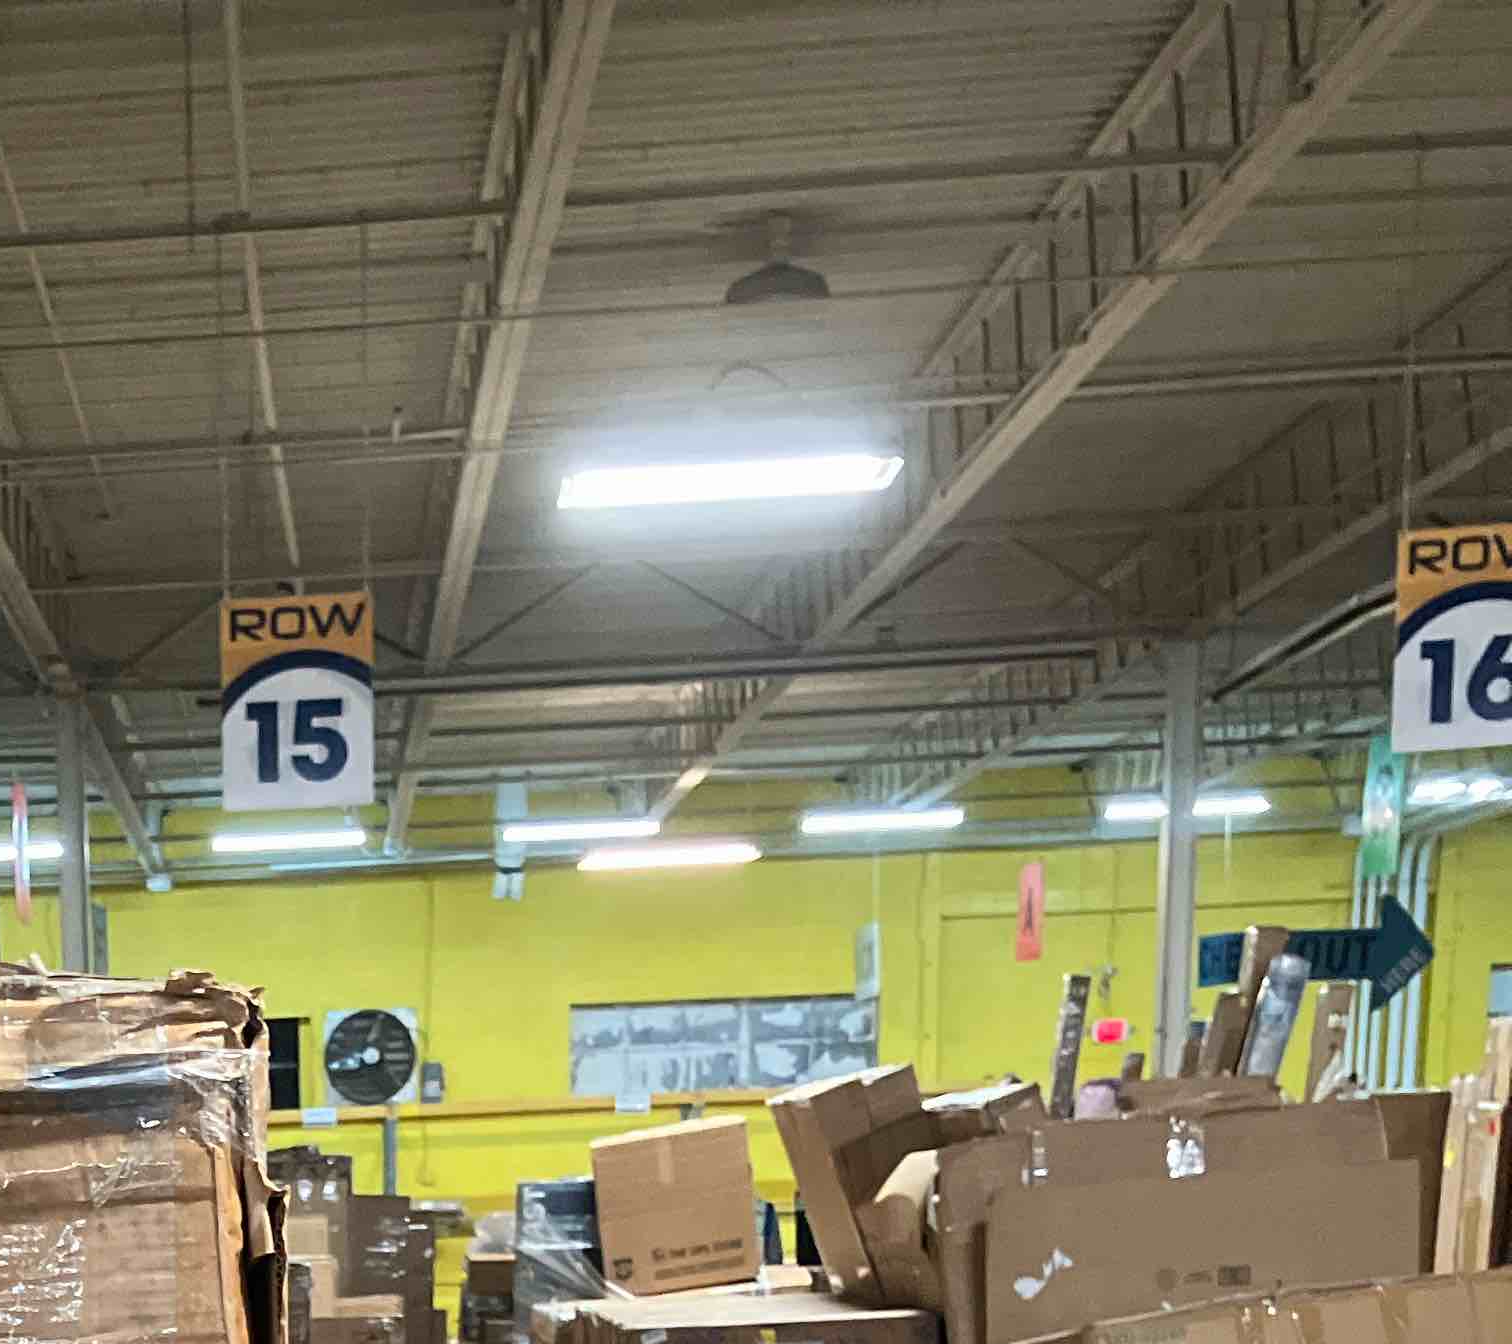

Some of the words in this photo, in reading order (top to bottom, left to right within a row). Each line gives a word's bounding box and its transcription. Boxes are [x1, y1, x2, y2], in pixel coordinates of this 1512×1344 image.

[227, 600, 365, 643] ROW
[1420, 633, 1512, 724] 16
[245, 697, 350, 784] 15
